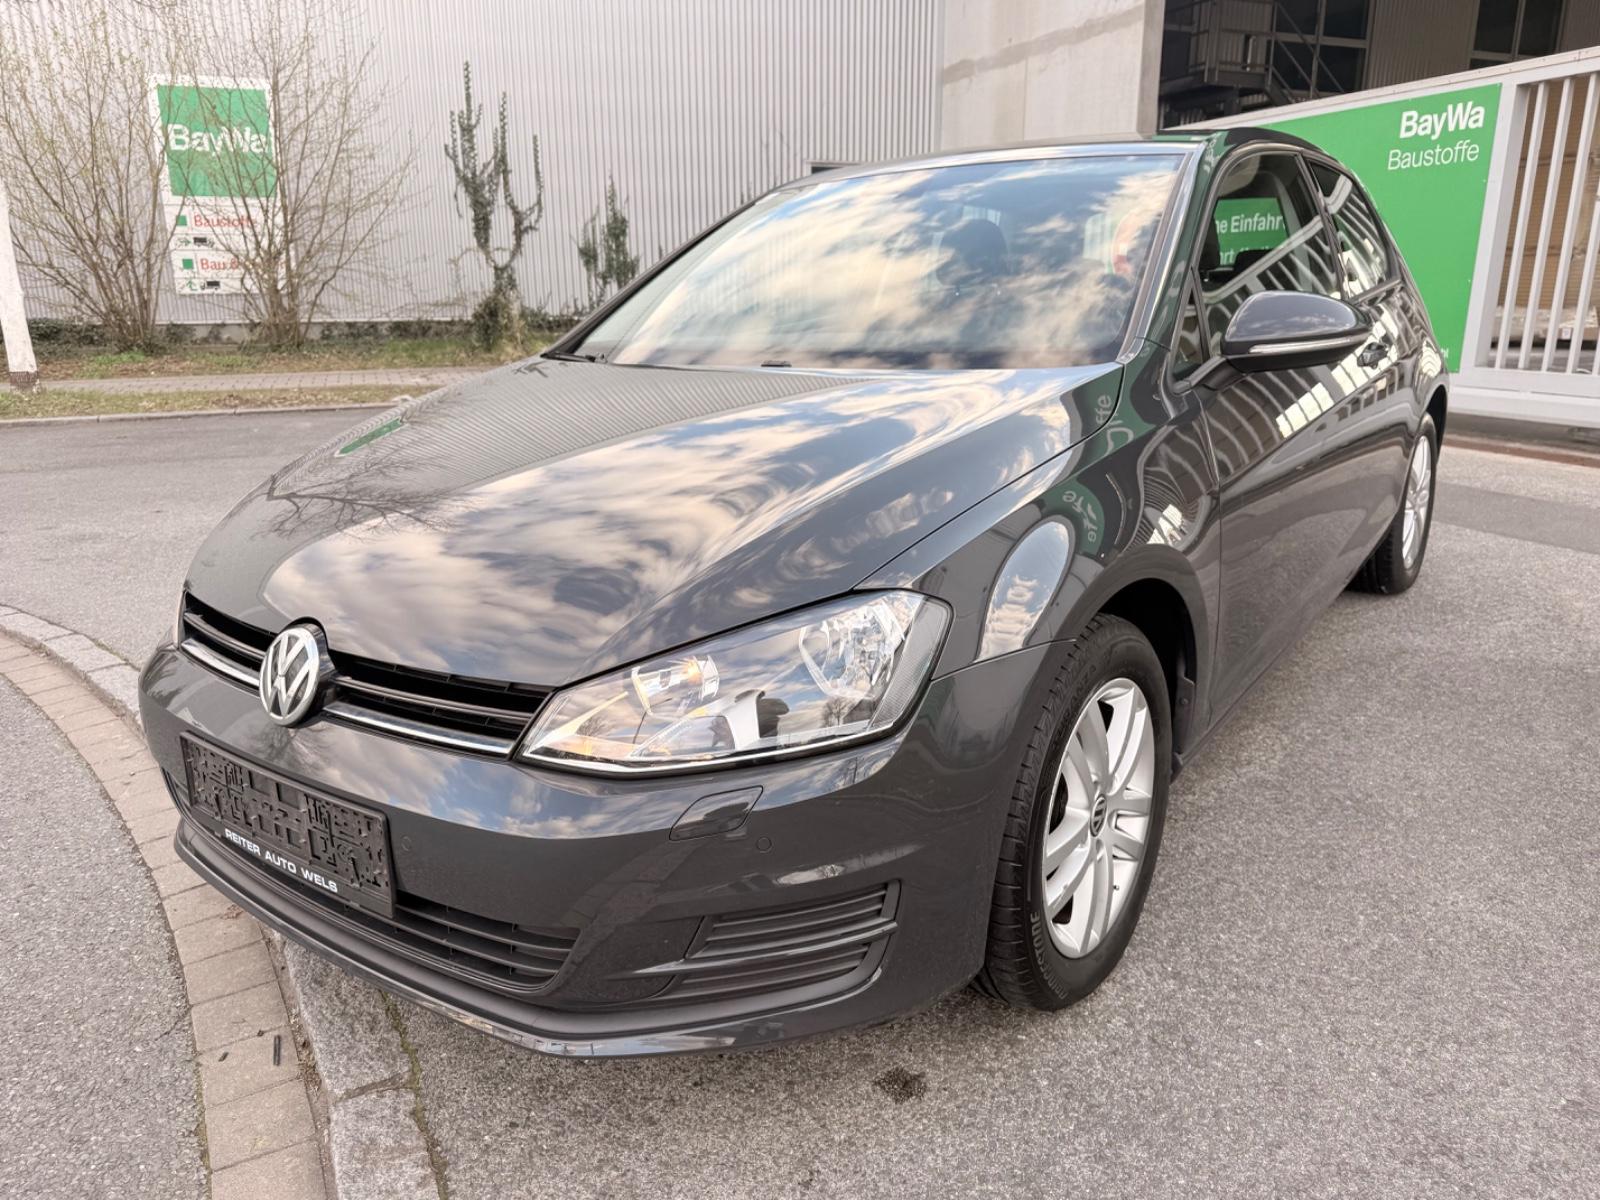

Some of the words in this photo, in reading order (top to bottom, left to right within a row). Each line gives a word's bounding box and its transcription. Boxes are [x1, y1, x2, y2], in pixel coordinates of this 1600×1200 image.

[1399, 101, 1485, 140] BayWa
[167, 123, 269, 157] BayWa
[1387, 139, 1480, 170] Baustoffe
[1230, 212, 1286, 233] Einfahr
[224, 828, 261, 856] REITER
[265, 850, 297, 874] AUTO
[301, 867, 338, 893] WELS
